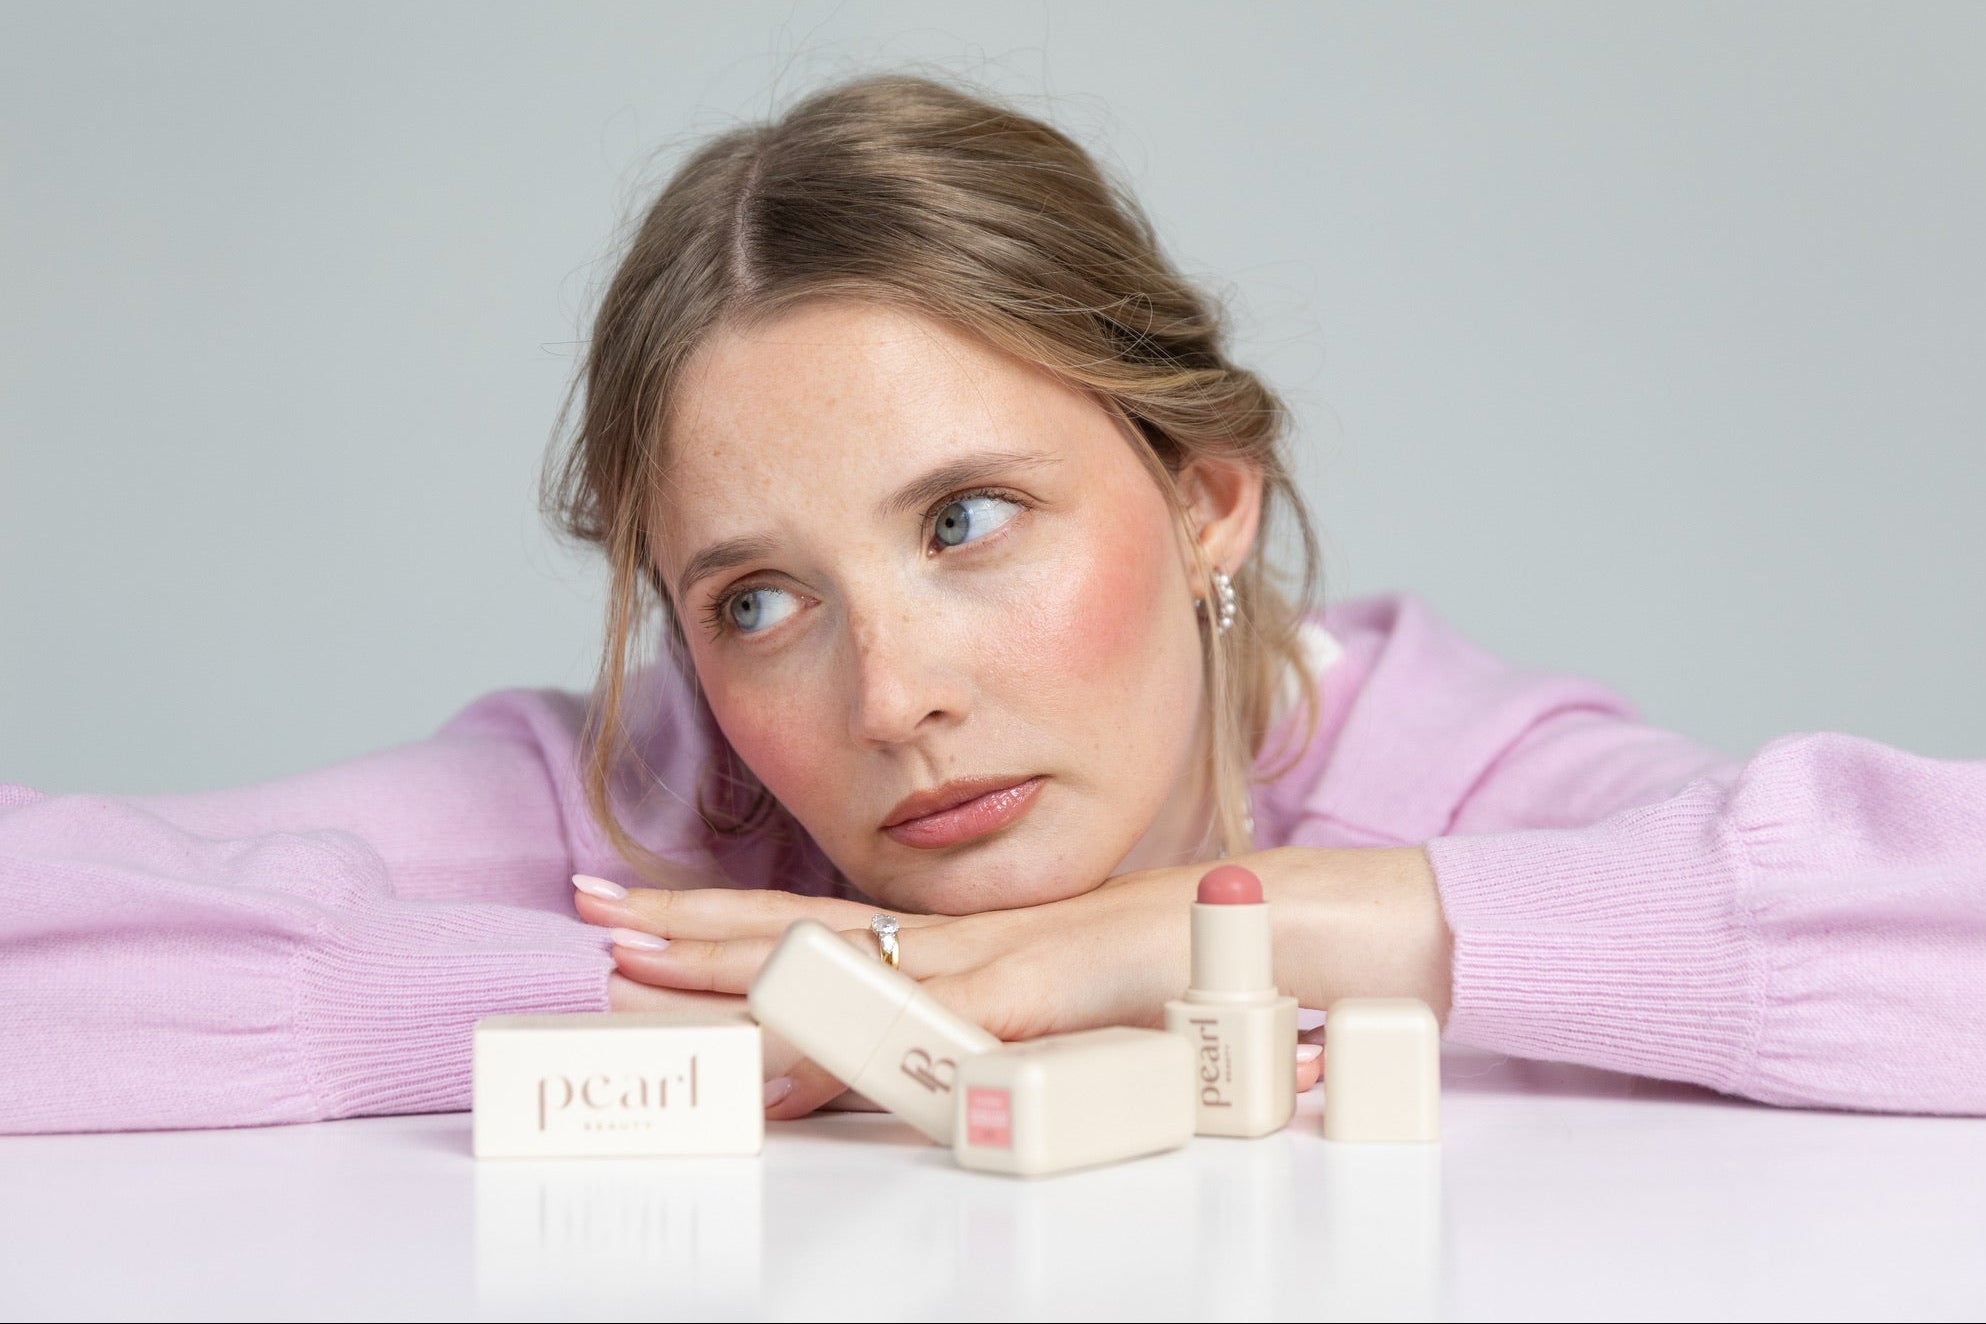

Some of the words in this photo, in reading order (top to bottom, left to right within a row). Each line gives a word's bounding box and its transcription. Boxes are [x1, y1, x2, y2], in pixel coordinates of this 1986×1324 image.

[538, 1054, 699, 1132] pearl
[1189, 1017, 1232, 1107] pearl
[583, 1121, 652, 1132] BEAUTY
